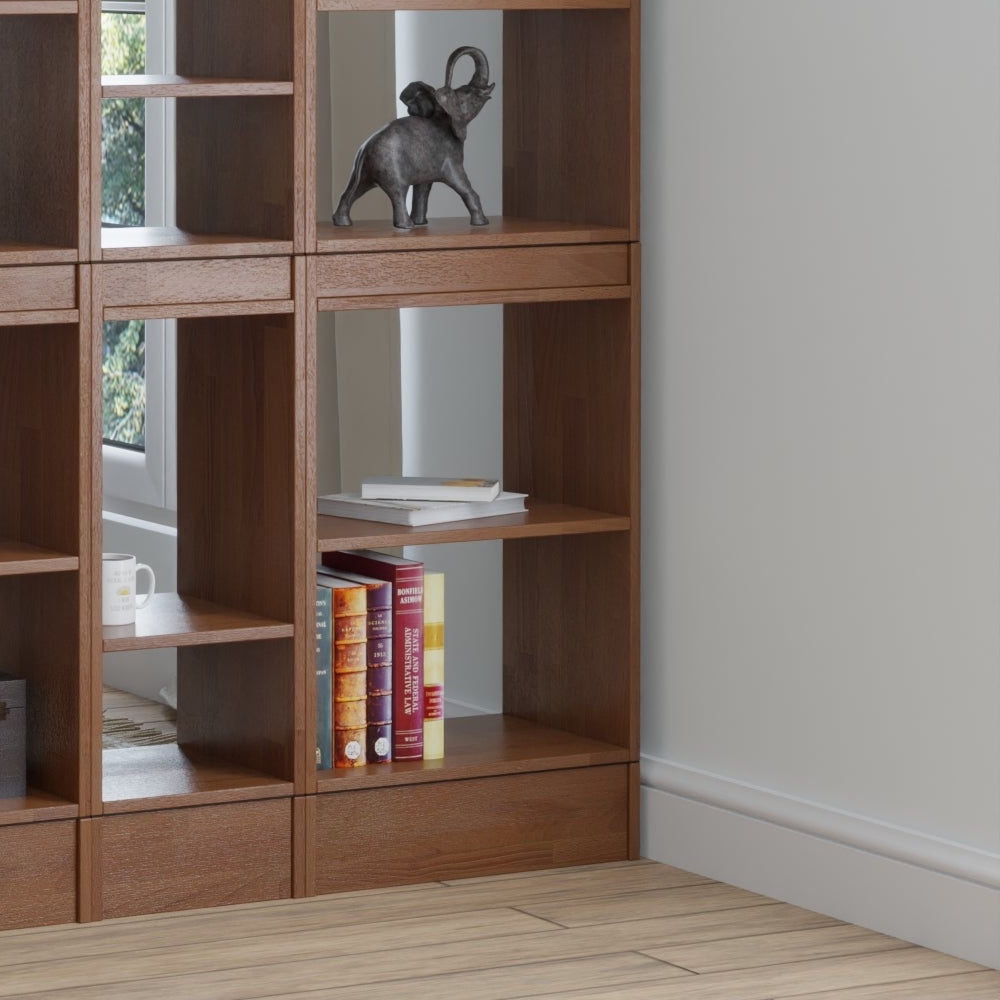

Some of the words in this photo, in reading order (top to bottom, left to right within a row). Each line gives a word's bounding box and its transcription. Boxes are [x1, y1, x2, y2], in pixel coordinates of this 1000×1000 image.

[404, 627, 412, 695] ADMINISTRATIVE
[403, 697, 412, 716] LAW
[411, 675, 419, 713] FEDERAL
